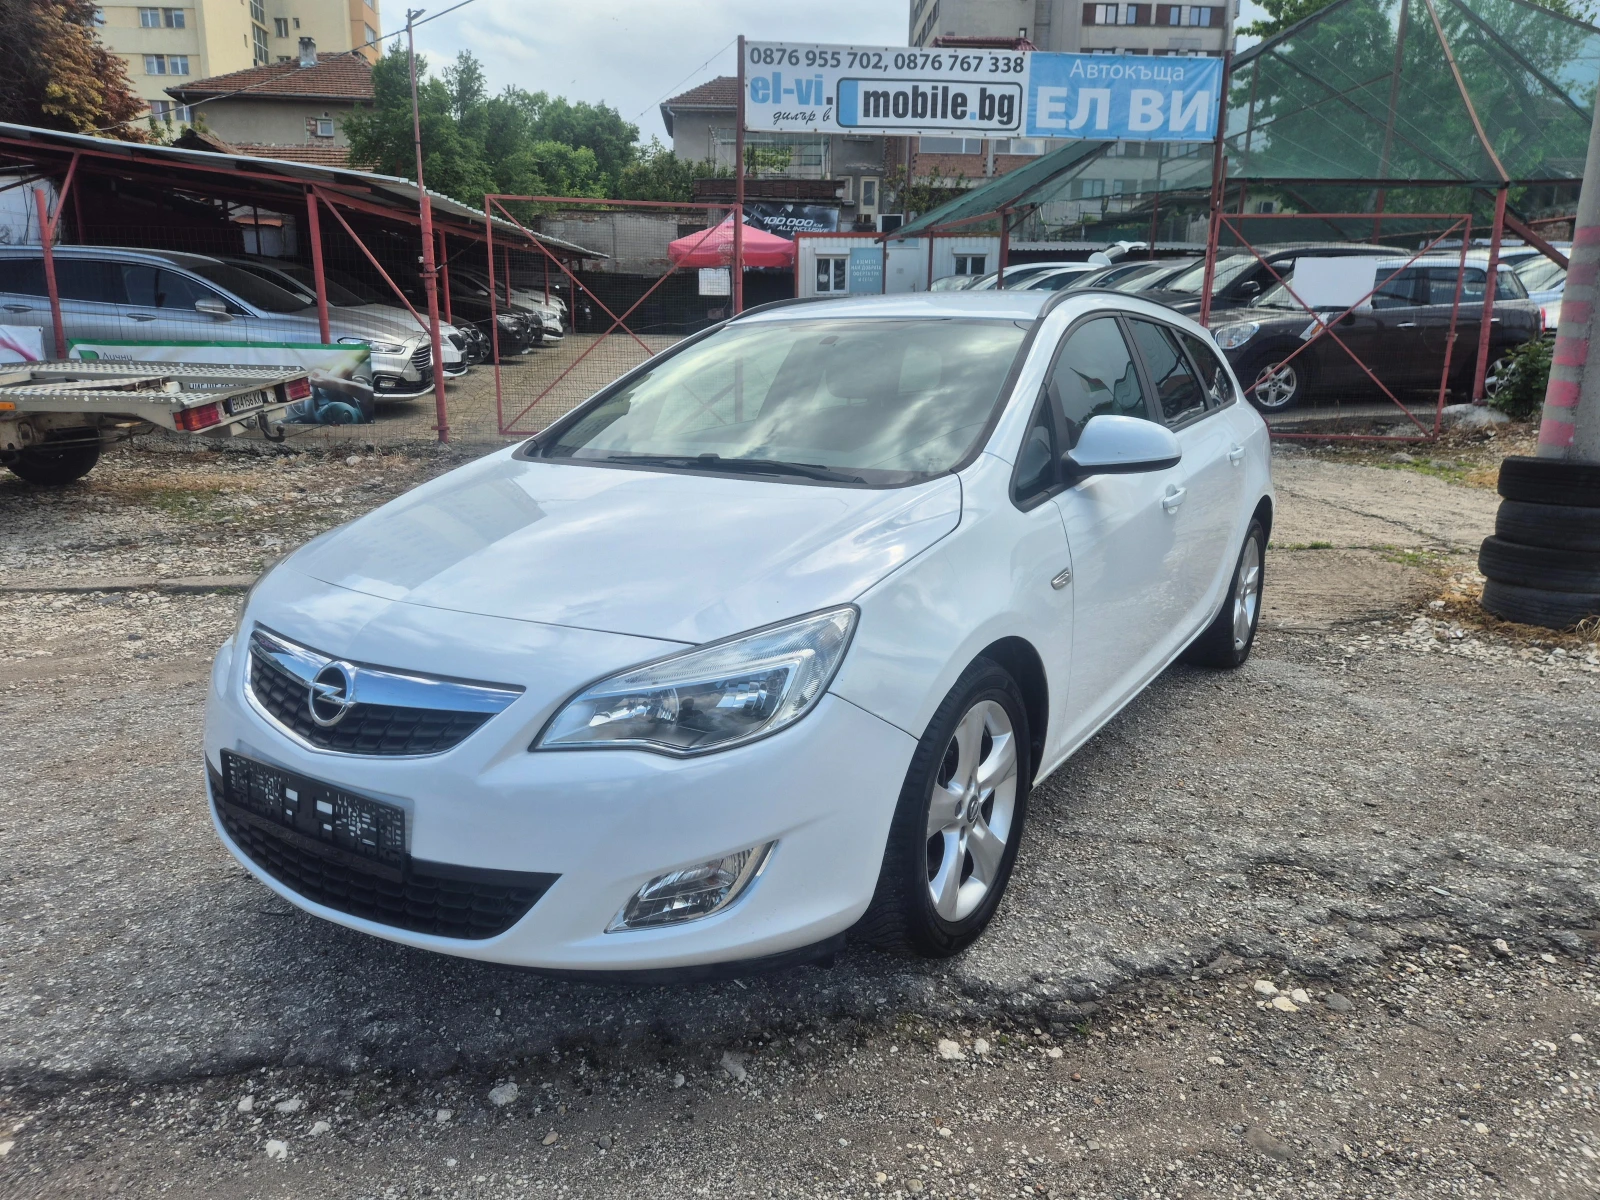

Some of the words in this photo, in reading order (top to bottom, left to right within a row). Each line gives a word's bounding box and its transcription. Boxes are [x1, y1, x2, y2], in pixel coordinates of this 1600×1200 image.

[750, 47, 800, 66] 0876
[805, 50, 841, 68] 955
[847, 52, 888, 72] 702,
[894, 53, 943, 71] 0876
[948, 54, 984, 72] 767
[988, 56, 1024, 74] 338
[1069, 59, 1184, 84] Автокъща
[773, 110, 817, 126] дилър
[863, 85, 1015, 126] mobile.bg
[1036, 86, 1111, 130] ЕЛ
[1128, 89, 1210, 132] ВИ
[763, 216, 786, 226] 100
[787, 218, 814, 227] 000
